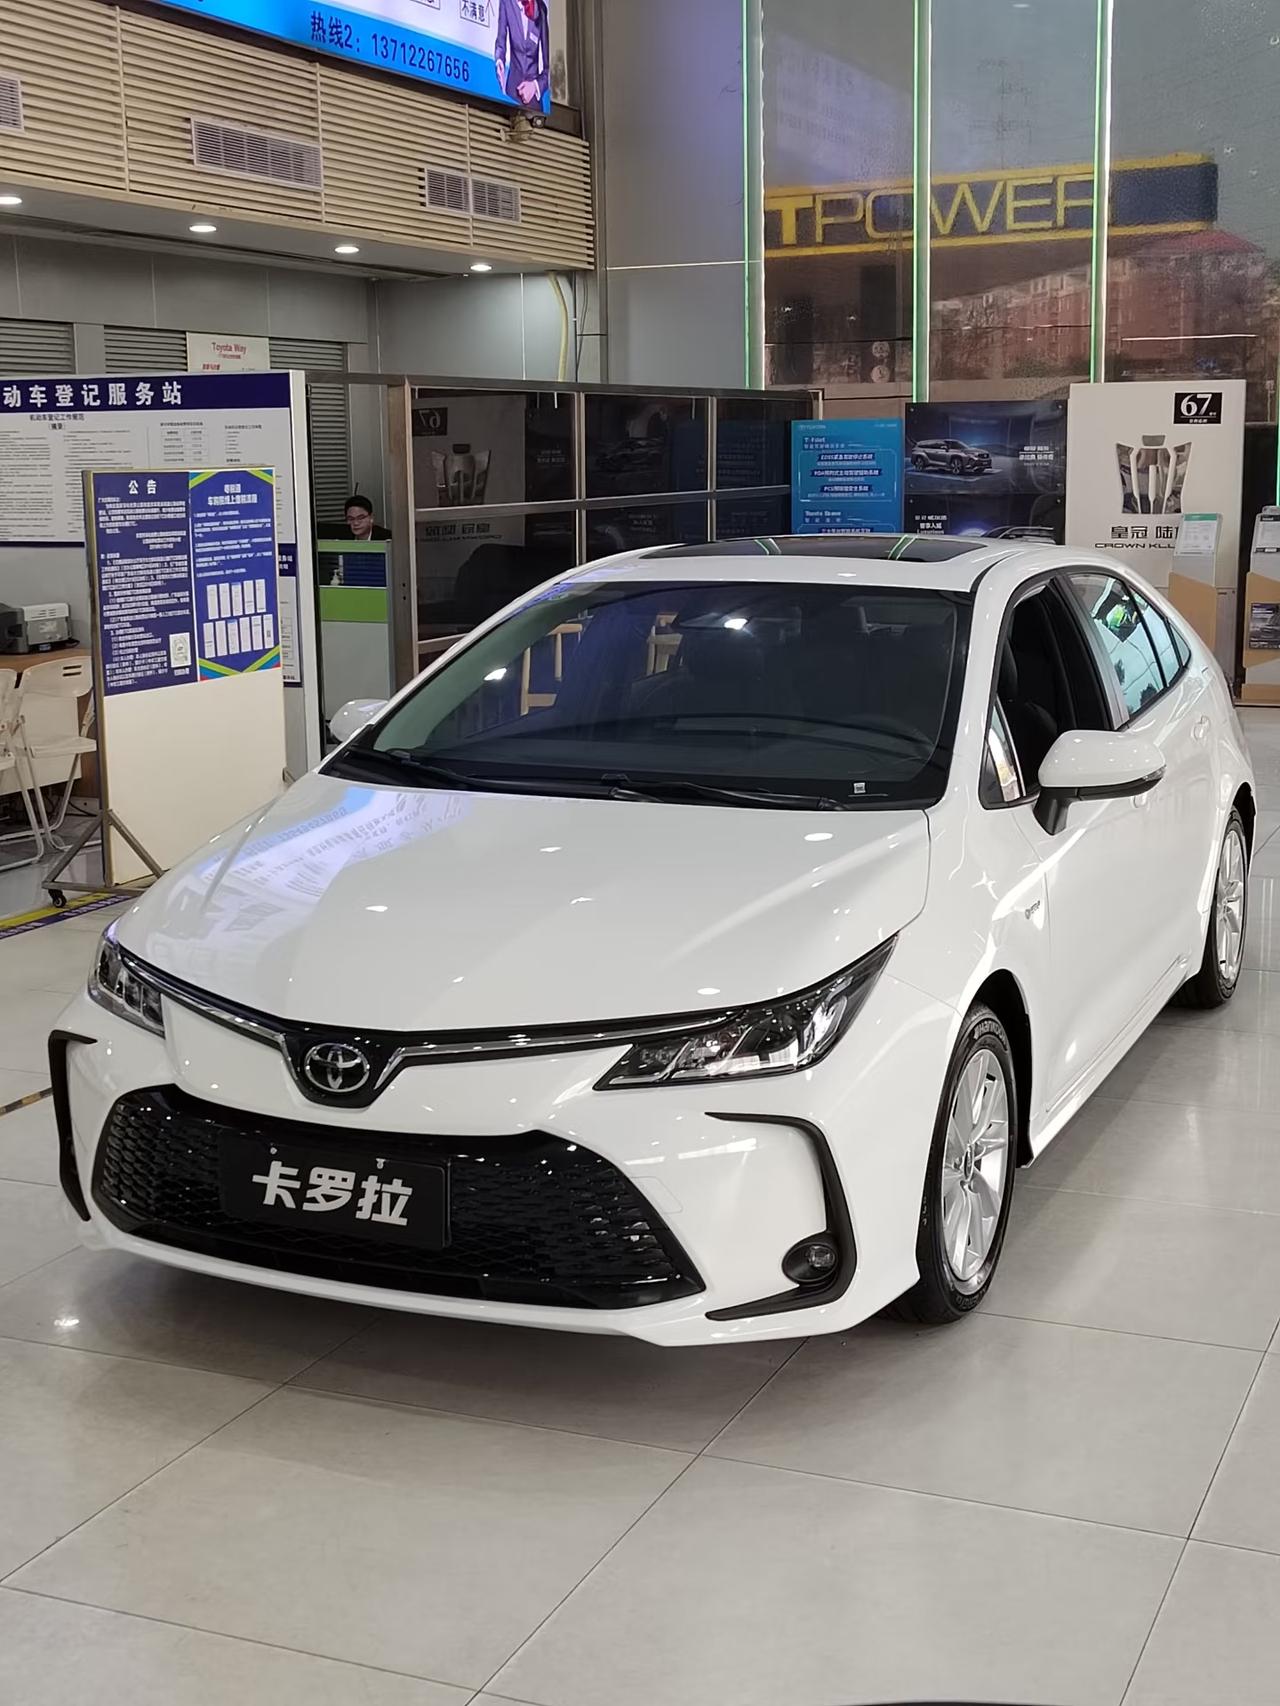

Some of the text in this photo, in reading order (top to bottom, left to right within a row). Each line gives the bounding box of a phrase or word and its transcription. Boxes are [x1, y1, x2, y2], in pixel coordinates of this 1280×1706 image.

[3, 381, 182, 408] 动车登记服务站
[1181, 394, 1212, 416] 67
[128, 480, 156, 494] 公告
[1111, 526, 1148, 539] 皇冠
[1156, 526, 1179, 539] 陆
[252, 1160, 413, 1227] 卡罗拉
